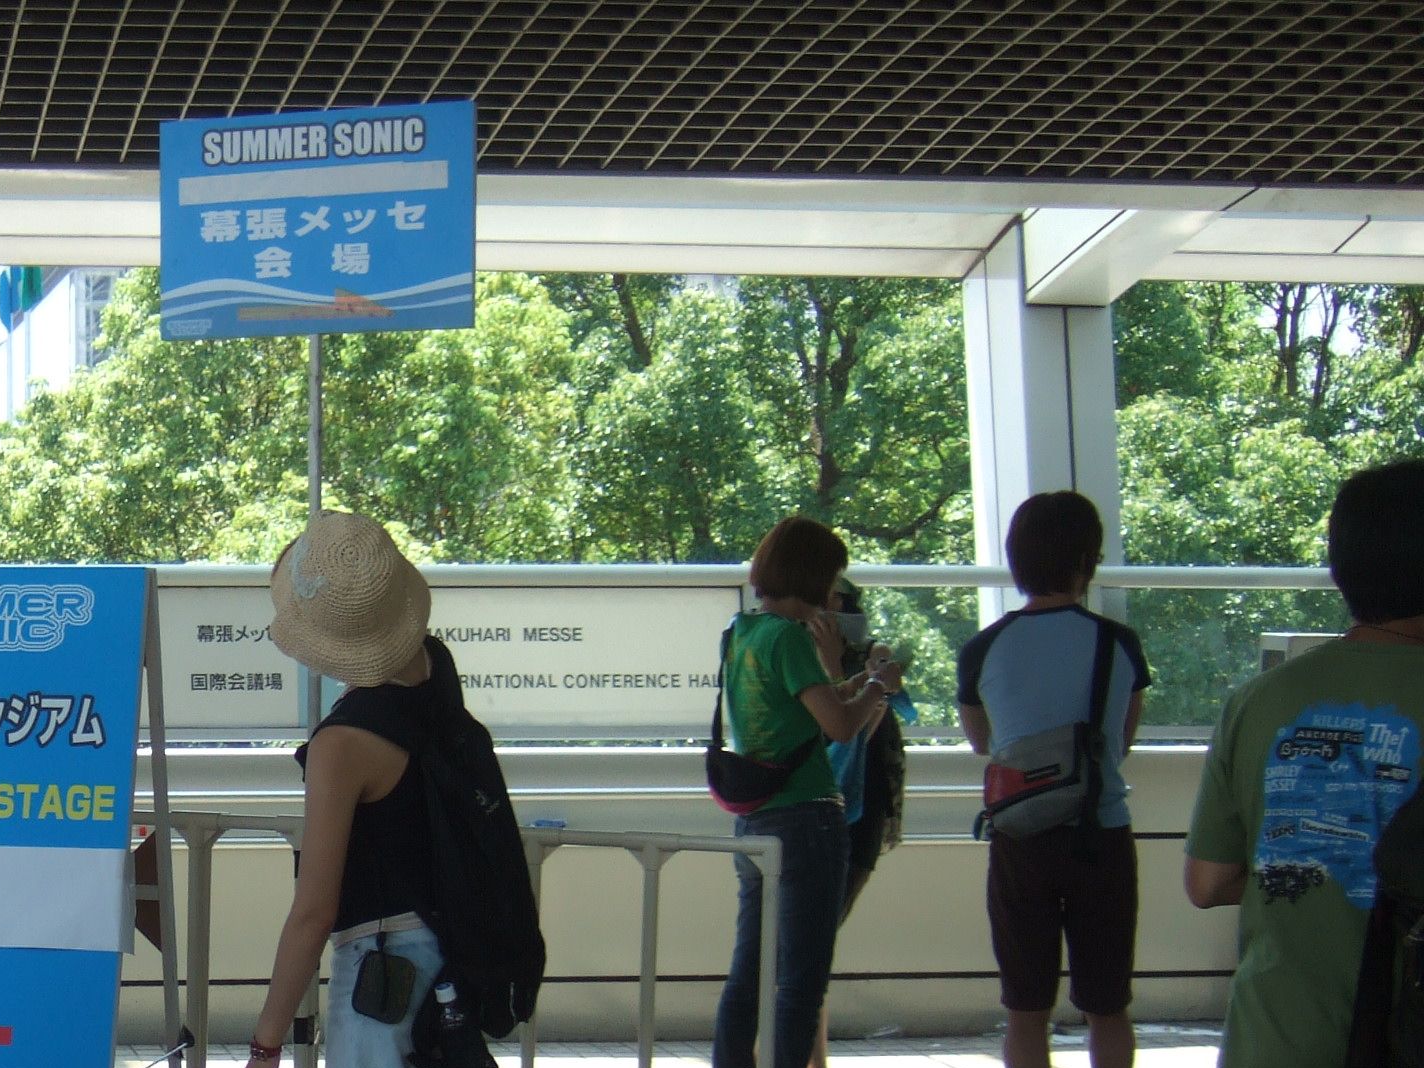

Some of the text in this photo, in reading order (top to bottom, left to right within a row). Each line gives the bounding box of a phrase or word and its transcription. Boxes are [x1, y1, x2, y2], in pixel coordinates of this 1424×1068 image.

[204, 117, 424, 165] SUMMER SONIC
[200, 200, 425, 243] 幕張メッセ
[523, 627, 583, 642] MESSE
[190, 672, 283, 692] 国際会議場
[460, 673, 719, 689] RNATIONAL CONFERENCE HAL
